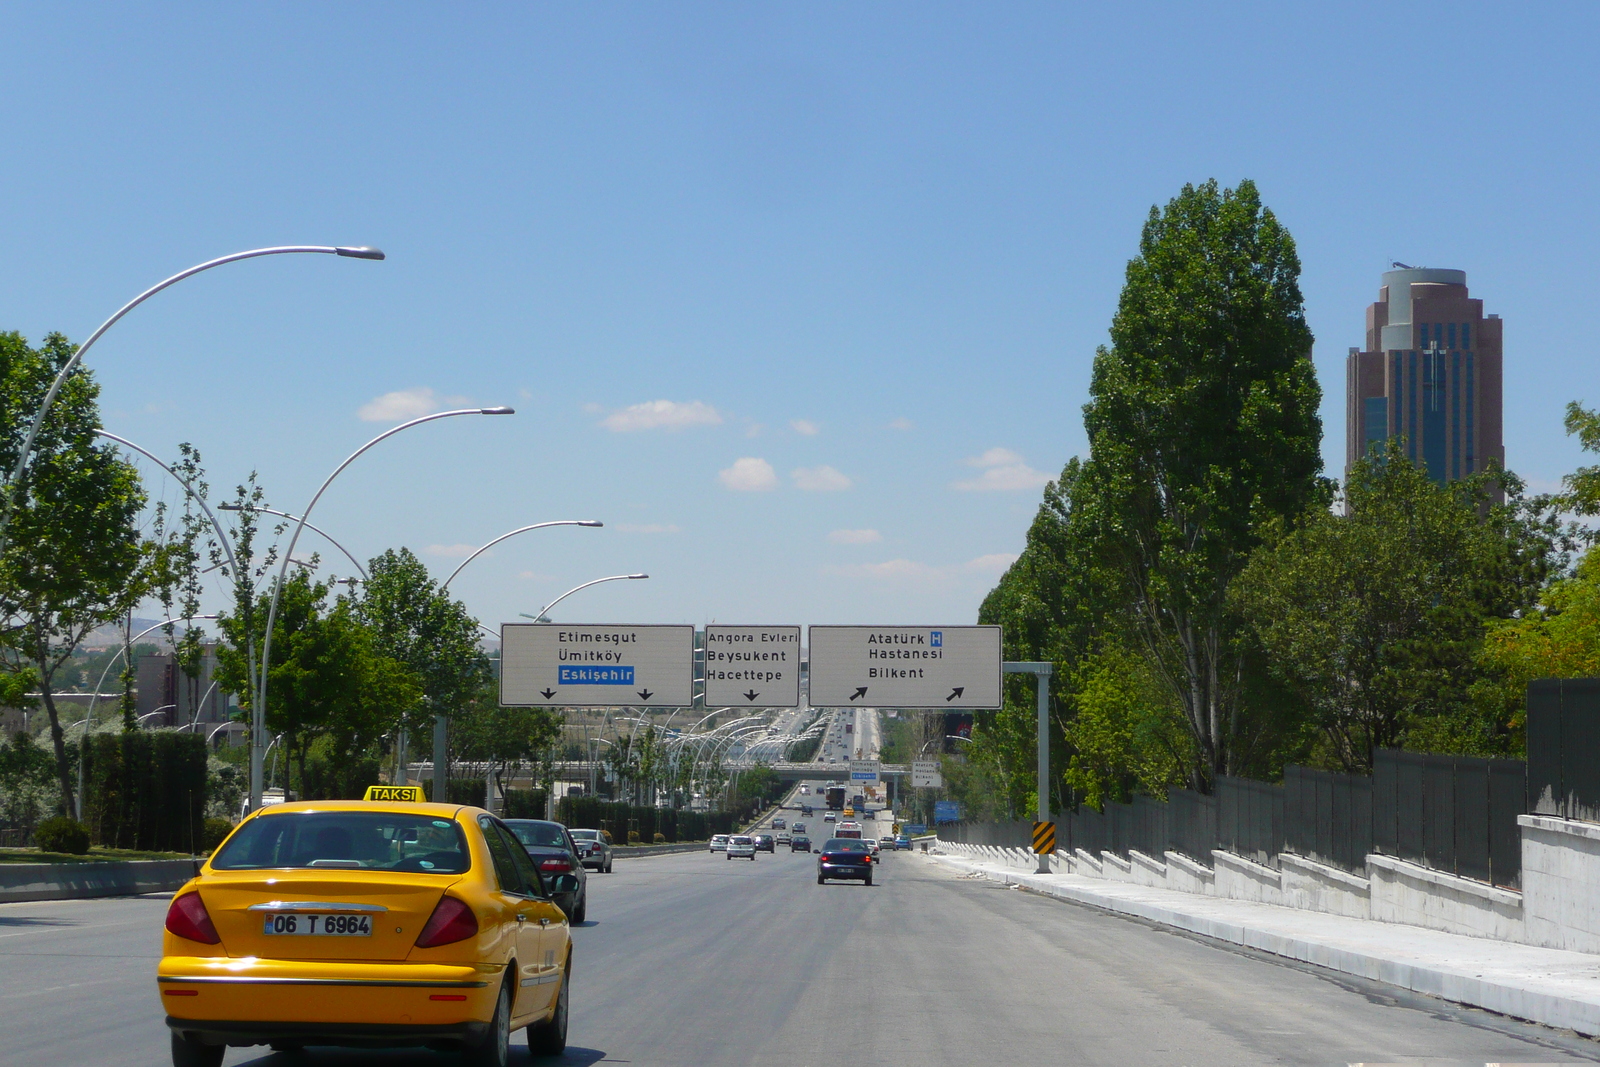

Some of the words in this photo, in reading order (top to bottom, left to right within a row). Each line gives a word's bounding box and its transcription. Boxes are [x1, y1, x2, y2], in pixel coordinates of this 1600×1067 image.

[558, 631, 637, 646] Etimesgut
[708, 633, 754, 645] Angora
[761, 633, 798, 643] Evleri
[867, 633, 925, 645] Atatürk
[931, 633, 941, 645] H
[558, 648, 622, 663] Ümitköy
[707, 650, 786, 663] Beysukent
[869, 648, 943, 659] Hastanesi
[561, 669, 633, 682] Eskişehir
[707, 669, 782, 683] Hacettepe
[869, 667, 924, 678] Bilkent
[274, 915, 297, 933] 06
[308, 916, 319, 933] T
[324, 916, 369, 934] 6964
